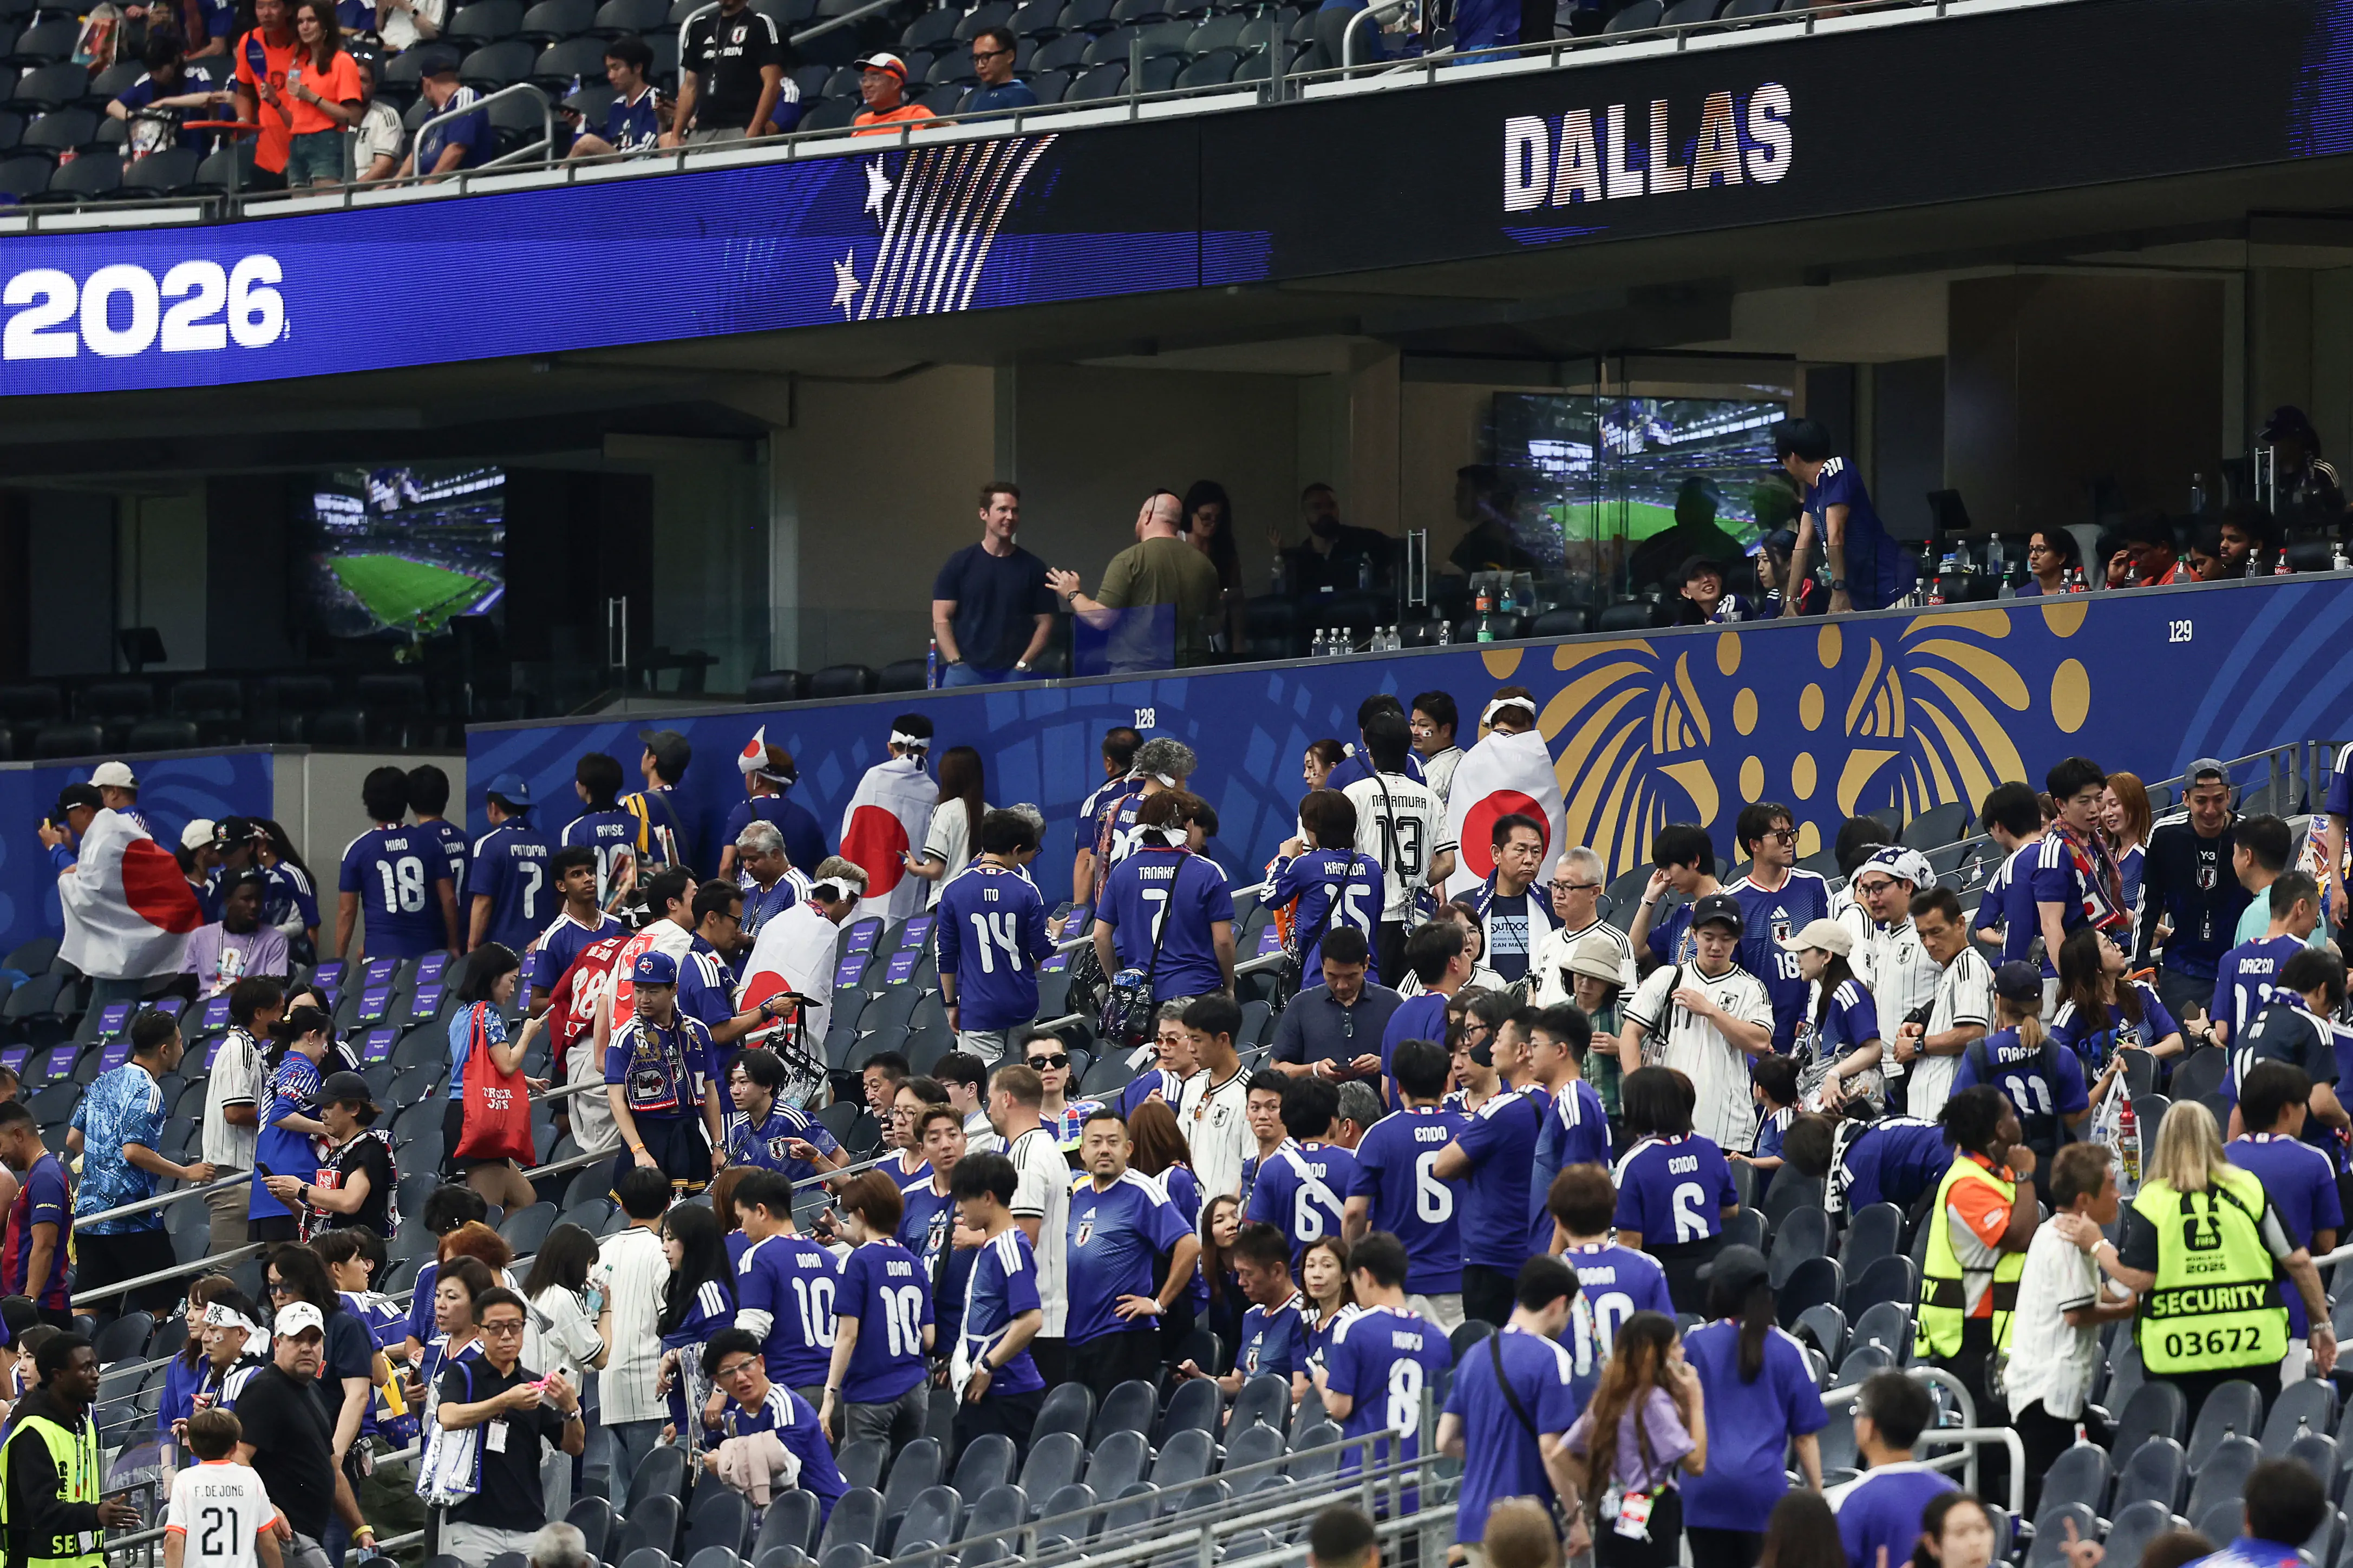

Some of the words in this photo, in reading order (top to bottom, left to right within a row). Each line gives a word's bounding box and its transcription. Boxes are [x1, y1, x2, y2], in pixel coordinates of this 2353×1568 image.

[1504, 82, 1793, 212] DALLAS
[2, 254, 284, 360] 2026
[2168, 620, 2192, 642] 129
[1134, 707, 1155, 730] 128
[1119, 810, 1137, 824] KUB
[385, 838, 408, 852] HIRO
[445, 841, 466, 855] ITOMA
[511, 844, 547, 857] MITOMA
[1376, 816, 1424, 877] 13
[2200, 851, 2215, 861] Y-3
[376, 856, 426, 914] 18
[450, 858, 465, 907] 7
[518, 861, 543, 919] 7
[983, 888, 999, 902] ITO
[1142, 888, 1172, 950] 7
[1324, 883, 1371, 943] 15
[971, 911, 1022, 973] 14
[1774, 952, 1801, 980] 18
[2004, 1075, 2052, 1117] 11
[1414, 1126, 1447, 1142] ENDO
[1295, 1162, 1327, 1179] DO
[1668, 1154, 1698, 1175] ENDO
[1415, 1151, 1453, 1224] 6
[1295, 1183, 1324, 1242] 6
[1672, 1182, 1710, 1244] 6
[796, 1253, 822, 1269] DOAN
[887, 1261, 912, 1277] DOAN
[792, 1277, 836, 1348] 10
[880, 1285, 923, 1357] 10
[2153, 1285, 2266, 1317] SECURITY
[1574, 1292, 1634, 1376] 10
[2166, 1327, 2261, 1357] 03672
[1387, 1358, 1423, 1438] 8
[195, 1486, 201, 1498] F.
[206, 1486, 218, 1498] DE
[220, 1485, 243, 1498] JONG
[201, 1507, 238, 1555] 21
